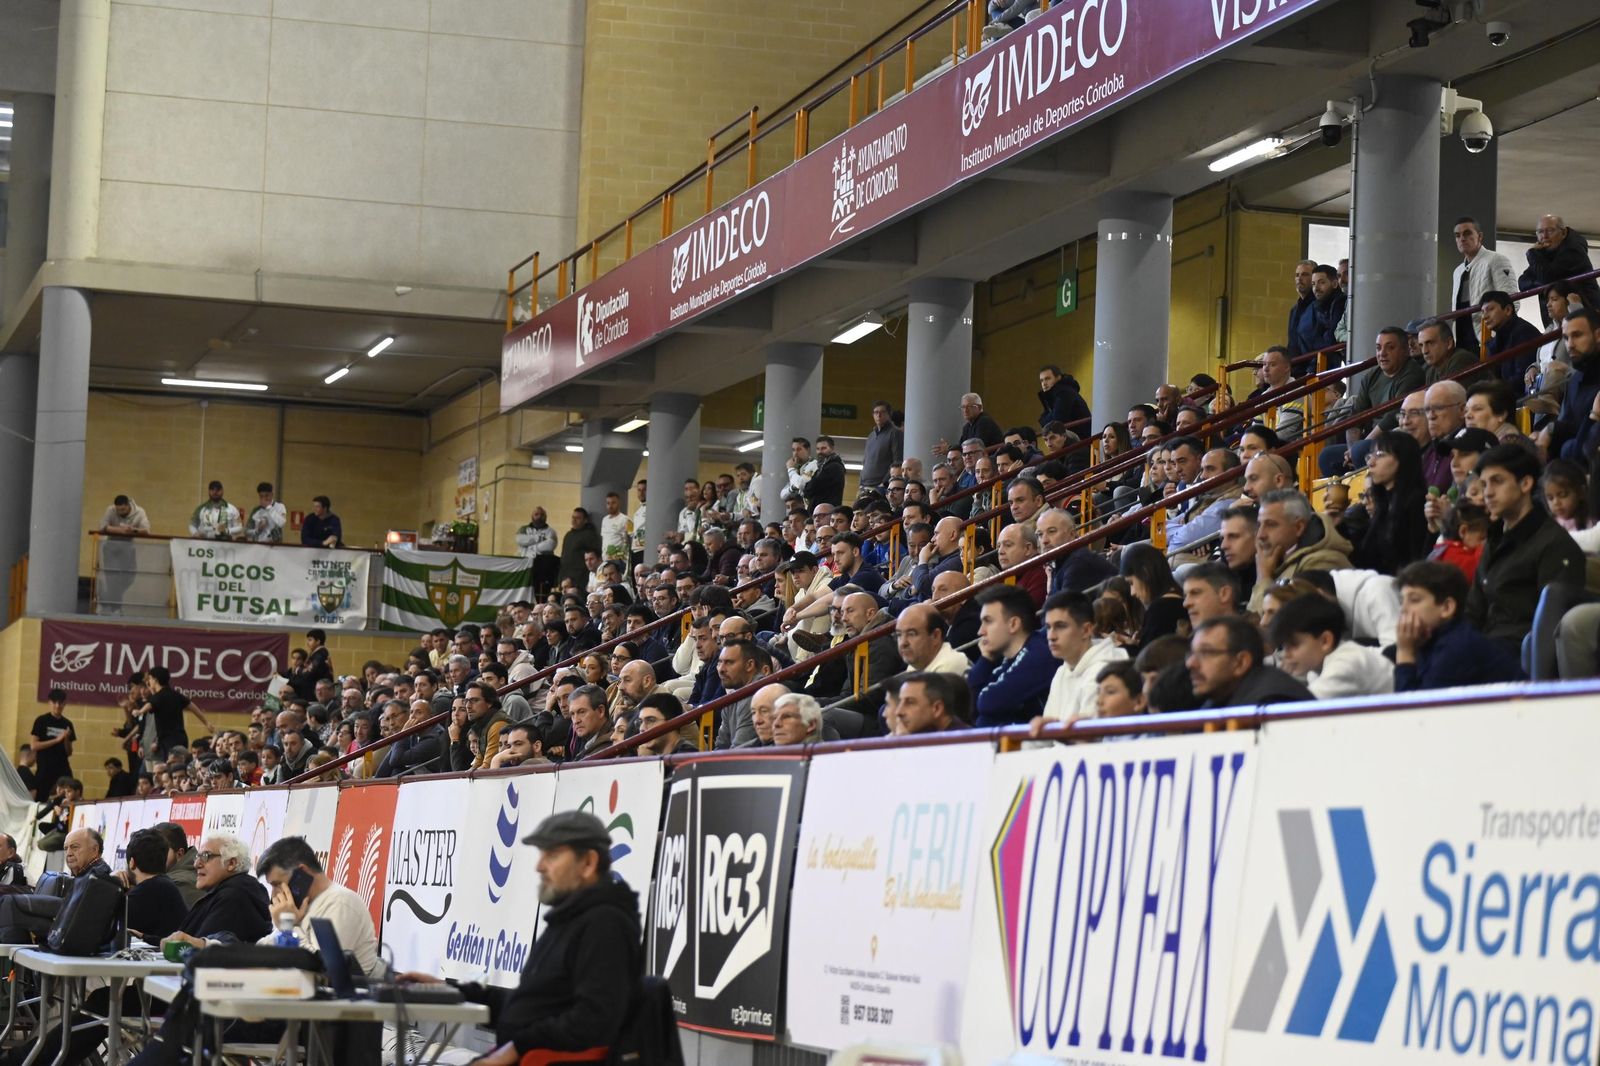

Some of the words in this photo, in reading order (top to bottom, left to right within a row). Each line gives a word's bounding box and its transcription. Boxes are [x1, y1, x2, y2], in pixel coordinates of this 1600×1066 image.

[997, 0, 1127, 117] IMDECO
[961, 144, 993, 172] Instituto
[993, 118, 1032, 156] Municipal
[1033, 115, 1044, 134] de
[1045, 97, 1085, 127] Deportes
[1086, 73, 1125, 106] Córdoba
[857, 123, 908, 176] AYUNTAMIENTO
[856, 181, 864, 210] DE
[865, 163, 898, 204] CÓRDOBA
[691, 191, 770, 281] IMDECO
[596, 288, 629, 325] Diputación
[670, 300, 689, 320] Instituto
[689, 286, 714, 311] Municipal
[712, 283, 720, 299] de
[720, 273, 744, 296] Deportes
[744, 260, 767, 283] Córdoba
[1062, 279, 1071, 307] G
[513, 323, 552, 374] IMDECO
[595, 329, 604, 350] de
[604, 315, 629, 345] Córdoba
[188, 547, 214, 559] LOS
[202, 562, 275, 581] LOCOS
[197, 593, 298, 617] FUTSAL
[218, 581, 246, 592] DEL
[50, 679, 96, 692] Instituto
[104, 642, 278, 683] IMDECO
[227, 688, 269, 701] Córdob
[388, 829, 457, 887] MASTER
[657, 833, 685, 930] RG3
[701, 832, 767, 936] RG3
[1020, 752, 1246, 1063] COPYFAX
[1415, 840, 1600, 963] Sierra
[446, 921, 485, 966] Gestión
[484, 936, 494, 973] y
[731, 1006, 772, 1026] rg3print.es
[1403, 963, 1593, 1066] Morena
